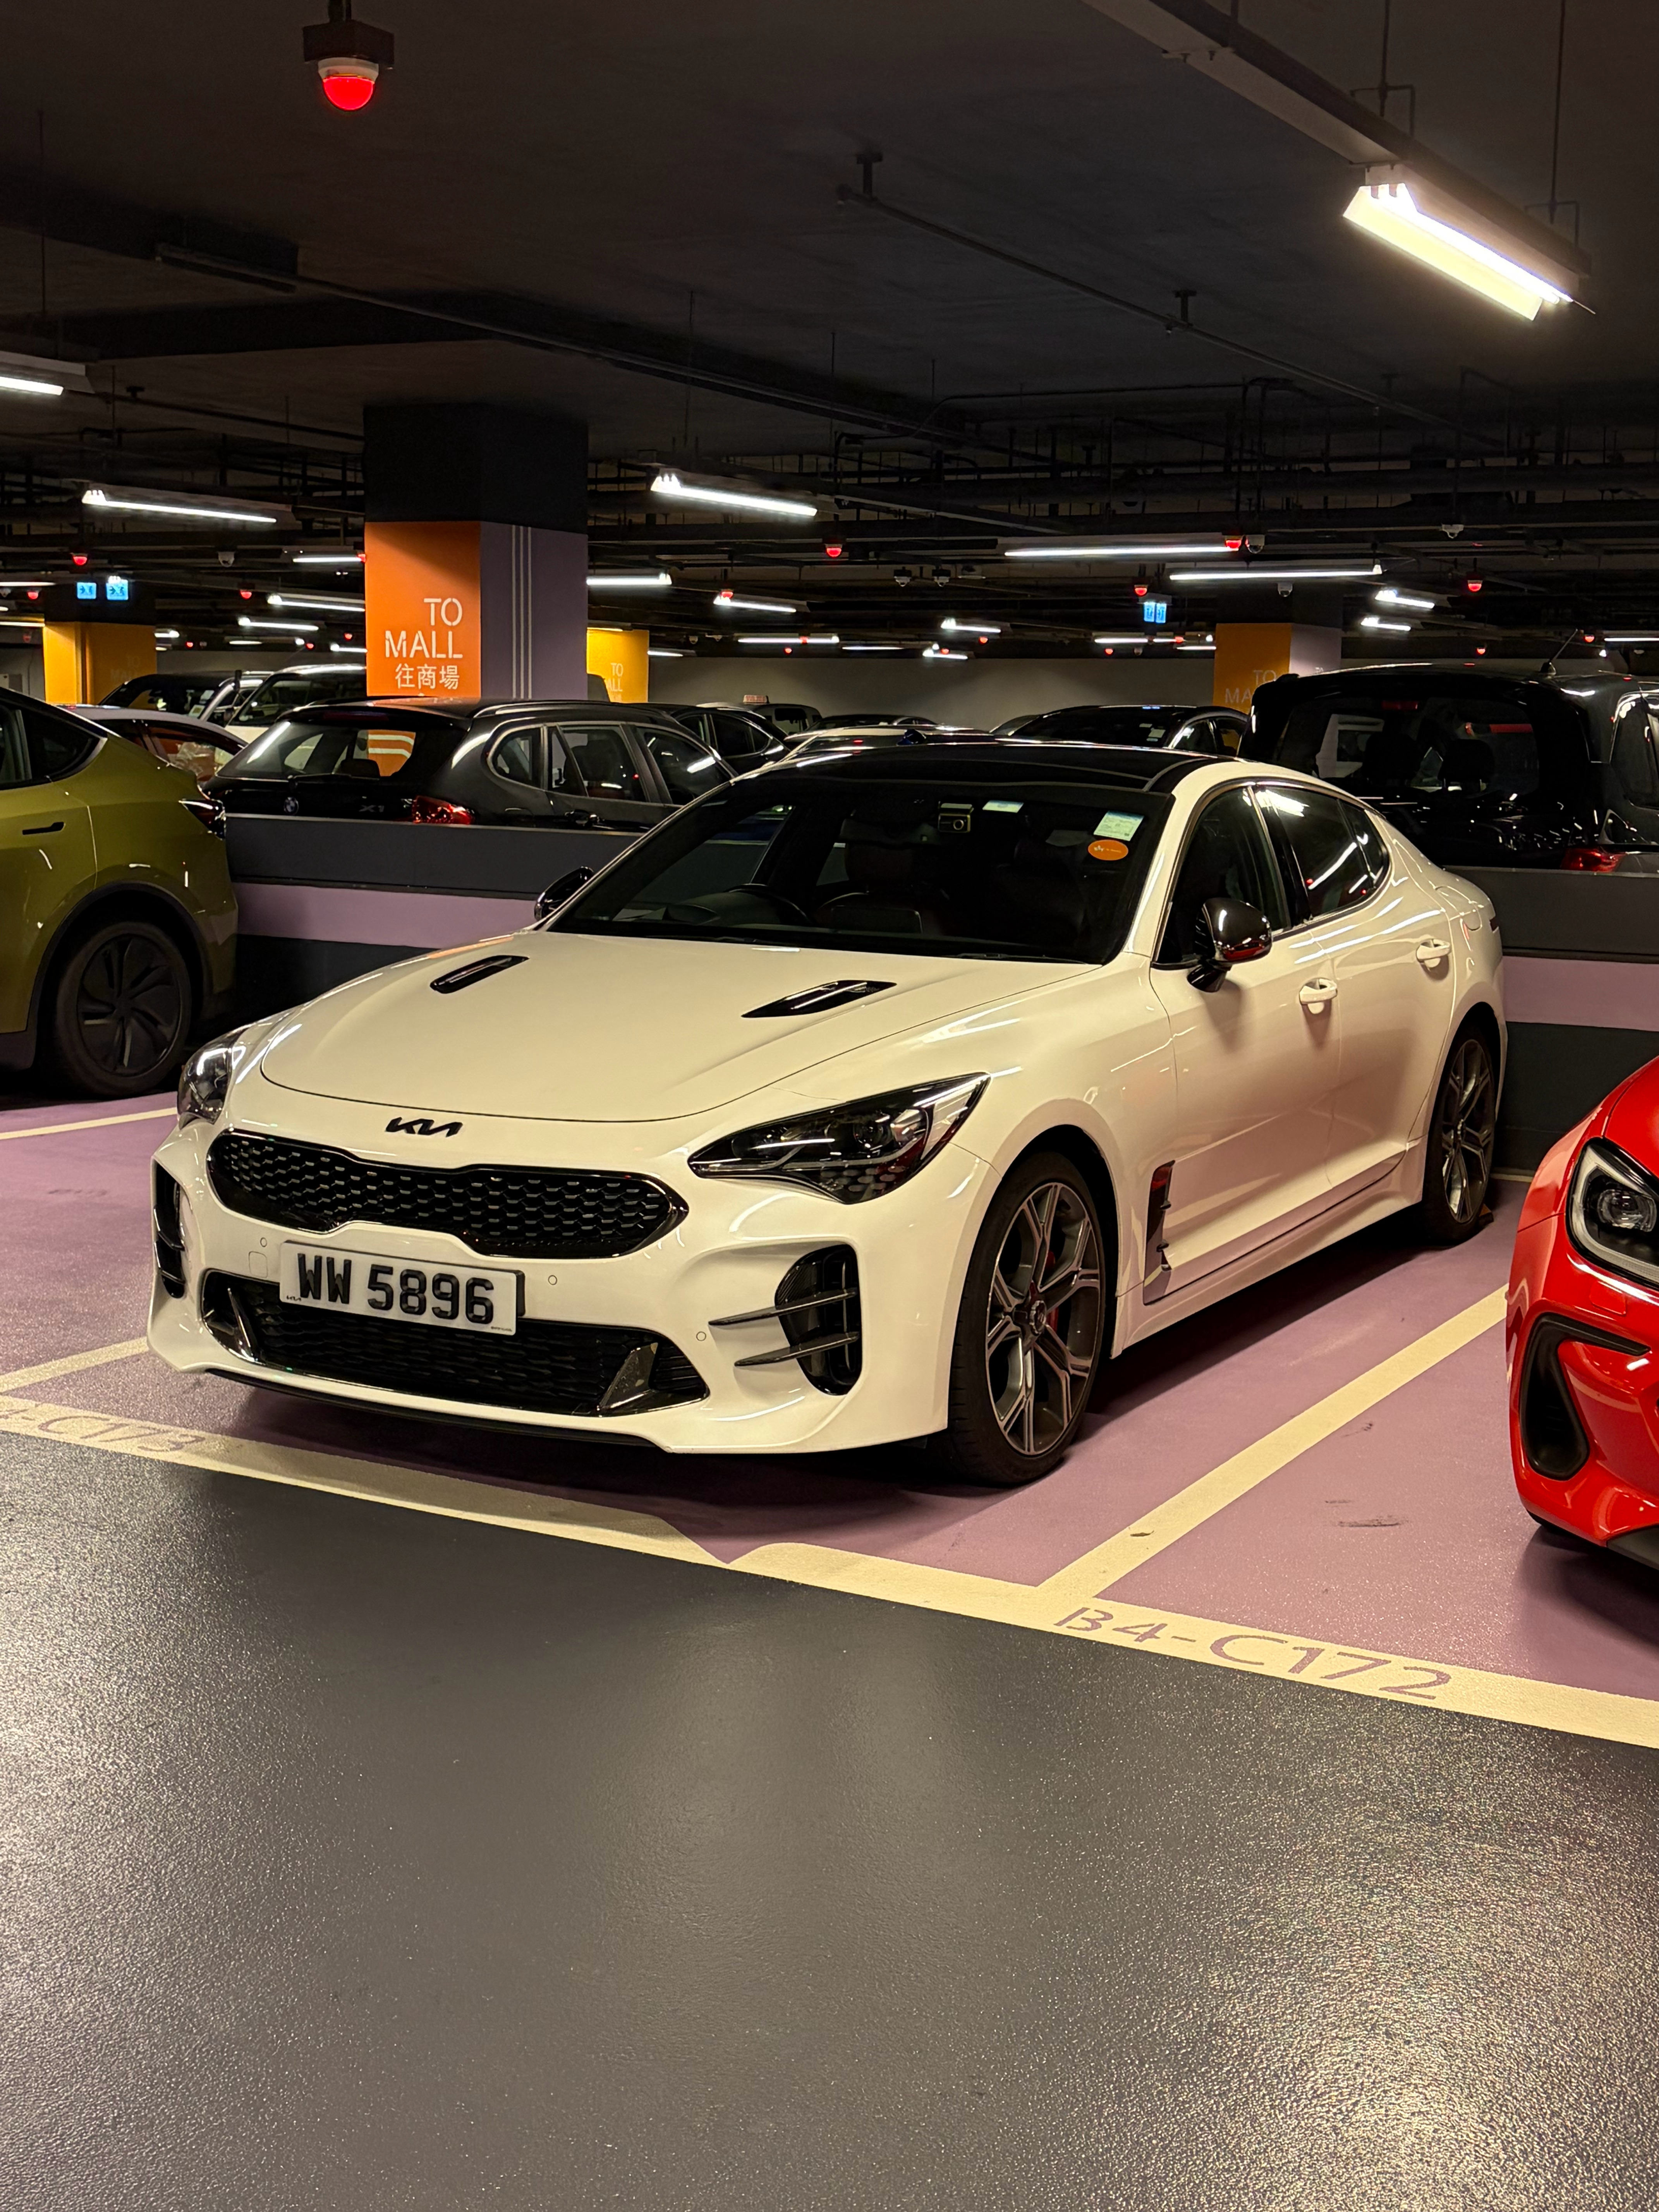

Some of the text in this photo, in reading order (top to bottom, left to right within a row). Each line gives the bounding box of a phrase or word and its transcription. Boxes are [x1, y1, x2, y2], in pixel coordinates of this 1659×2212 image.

[424, 598, 462, 626] TO
[385, 630, 463, 658] MALL
[395, 663, 460, 689] 往商場
[610, 663, 623, 677] TO
[1254, 670, 1277, 685] TO
[605, 677, 623, 692] ALL
[1225, 687, 1252, 703] MA
[298, 1253, 494, 1324] WW 5896
[1053, 1607, 1451, 1699] B4-C172
